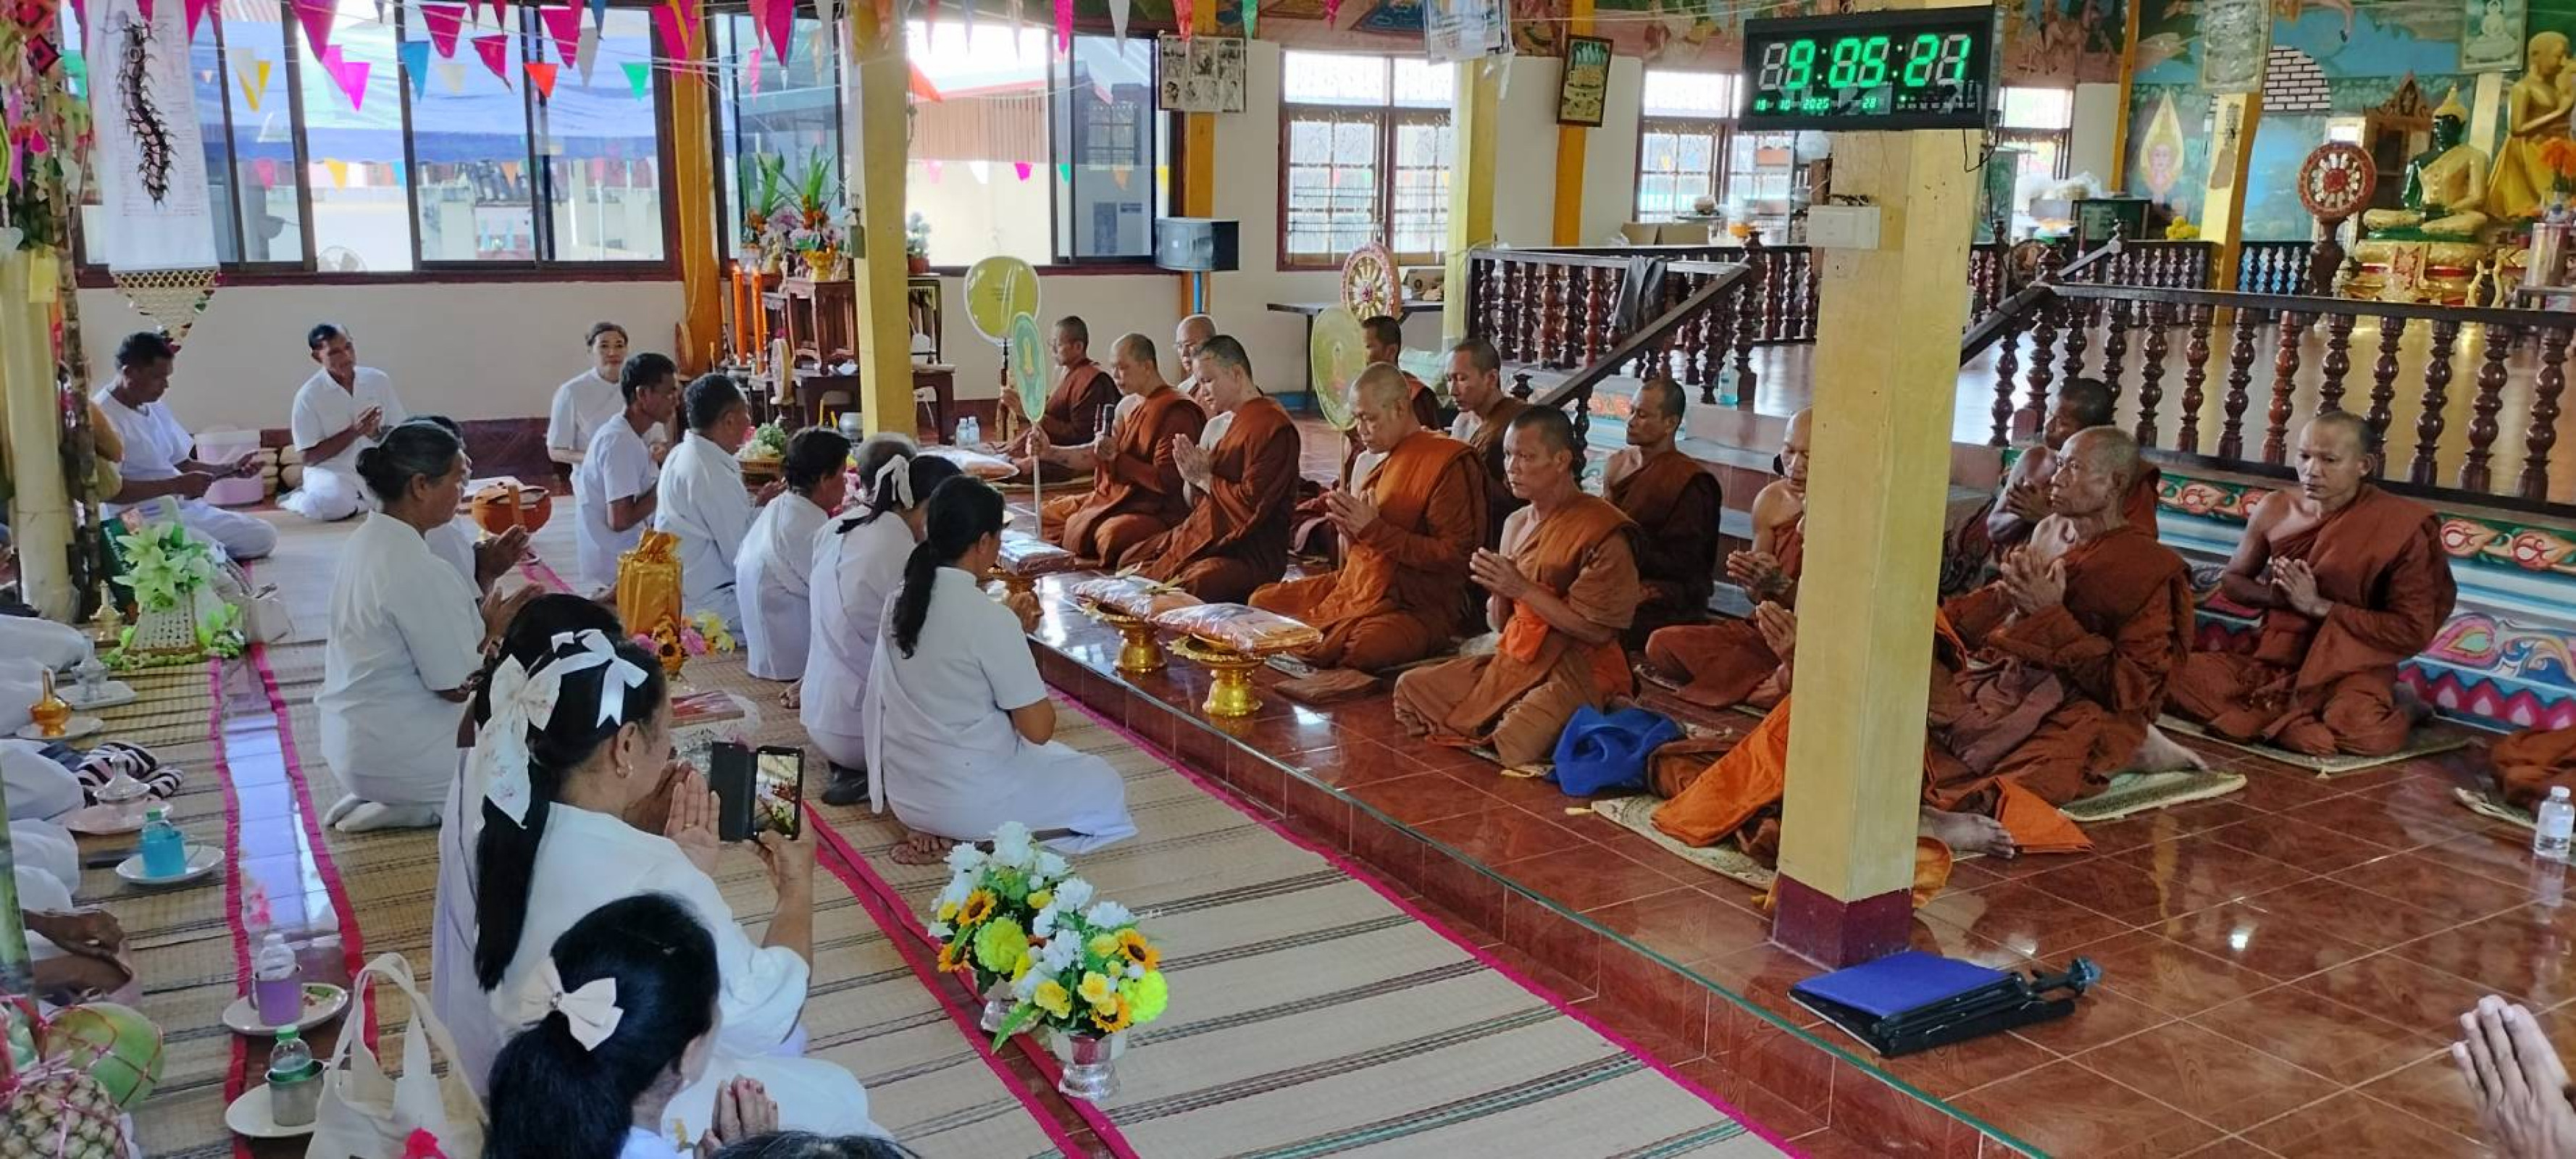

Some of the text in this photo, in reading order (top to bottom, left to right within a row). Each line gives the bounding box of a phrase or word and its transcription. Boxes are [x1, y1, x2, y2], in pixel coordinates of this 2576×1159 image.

[1786, 34, 1971, 88] 9:05:21
[1802, 98, 1830, 110] 2025
[1862, 96, 1877, 109] 28
